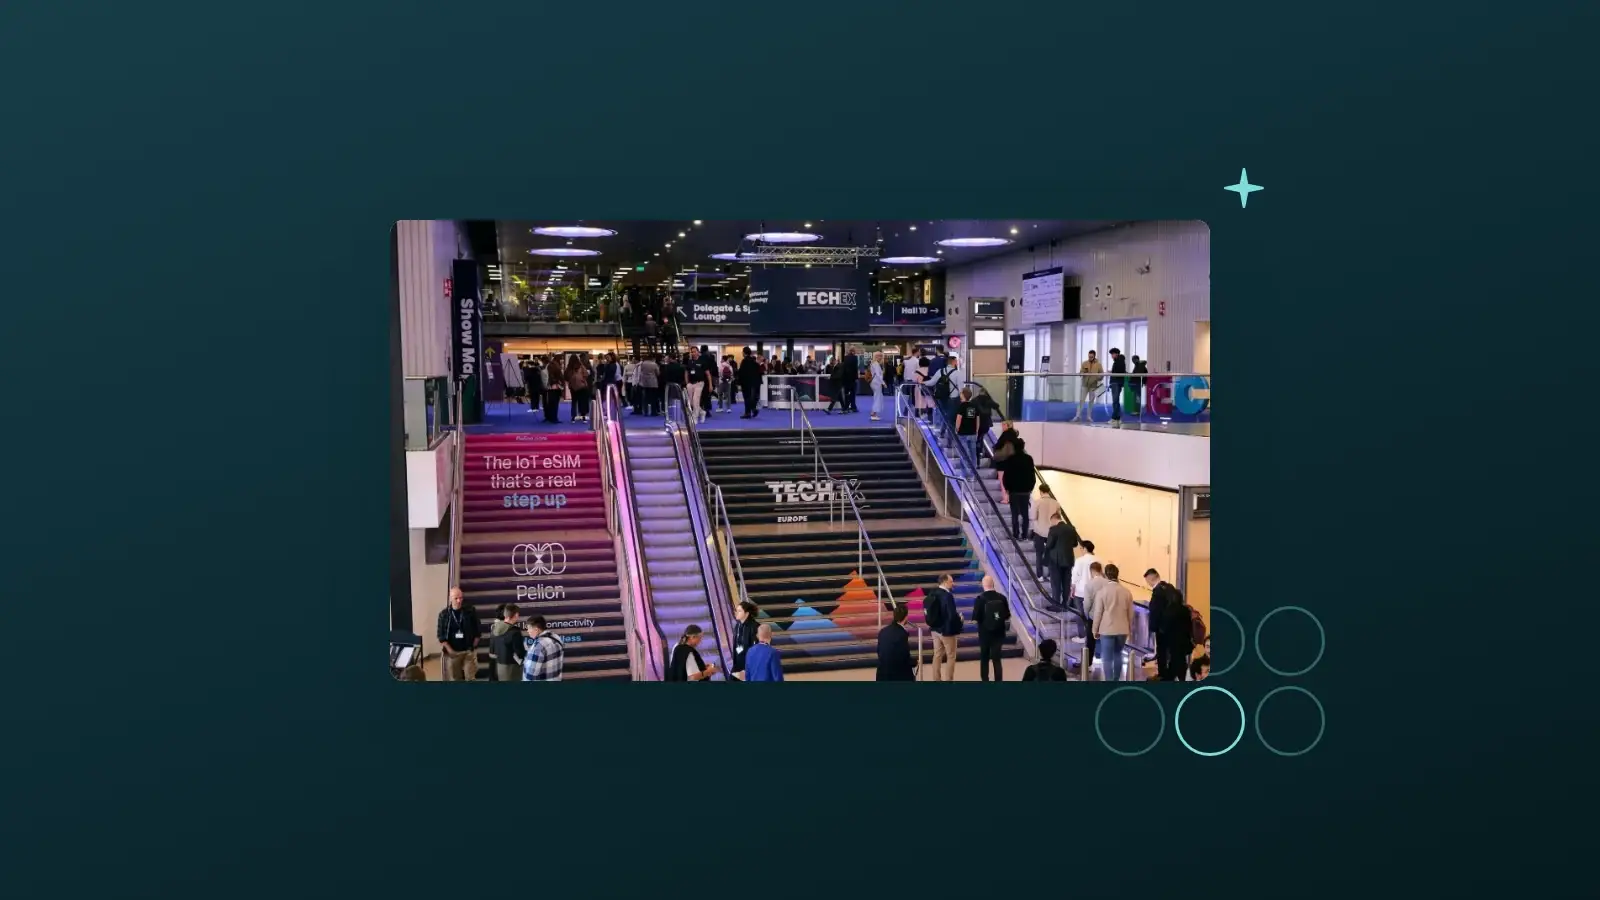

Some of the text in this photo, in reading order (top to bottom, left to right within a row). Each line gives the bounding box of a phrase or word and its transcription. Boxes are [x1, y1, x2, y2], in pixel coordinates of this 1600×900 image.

[796, 291, 857, 305] TECHEX
[693, 304, 734, 314] Delegate
[901, 306, 928, 314] Hall 10
[461, 298, 475, 346] Show
[693, 313, 727, 323] Lounge
[482, 454, 581, 470] The IoT eSIM
[490, 472, 577, 489] that's a real
[503, 492, 568, 512] step up
[777, 515, 808, 523] EUROPE
[516, 583, 565, 600] Pelion
[545, 618, 595, 629] onnectivity
